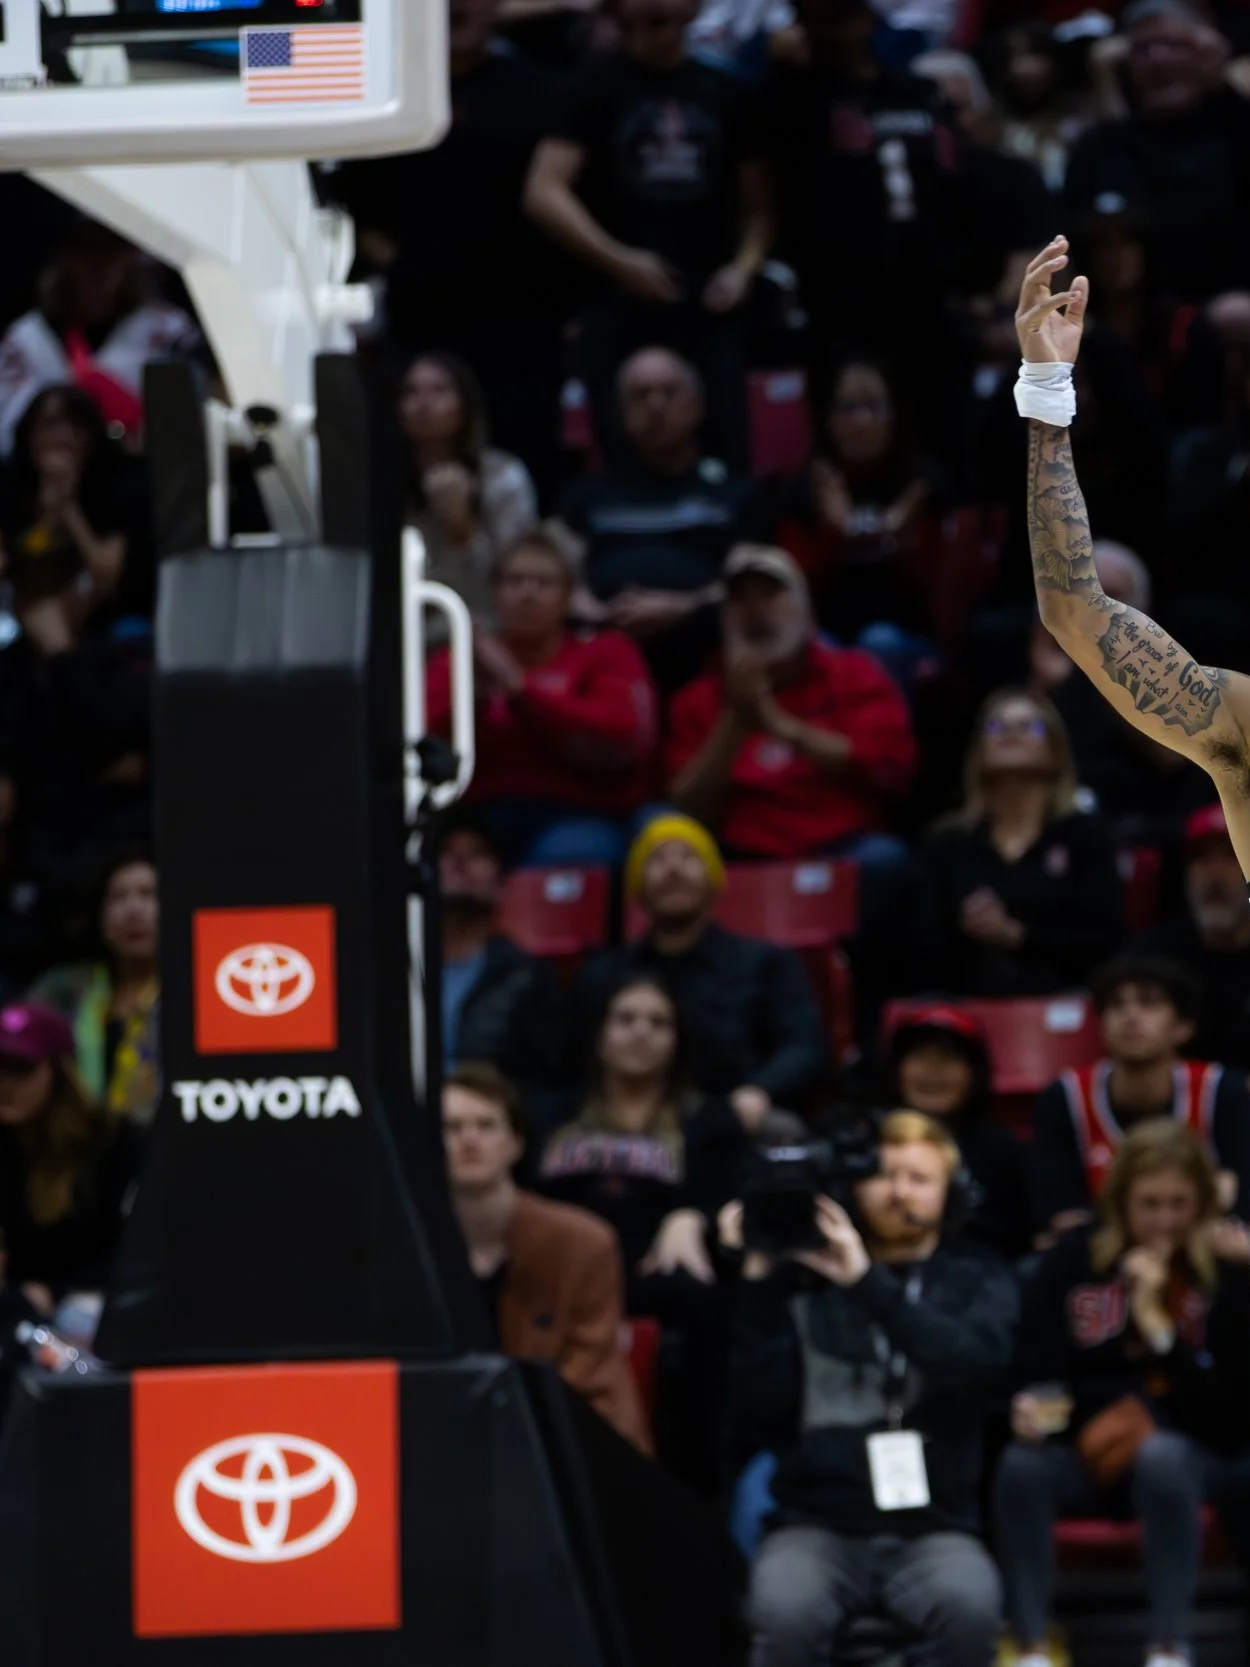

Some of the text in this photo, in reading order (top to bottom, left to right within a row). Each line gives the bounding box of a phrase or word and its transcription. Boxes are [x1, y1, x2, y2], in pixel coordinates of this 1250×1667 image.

[1143, 678, 1169, 698] what
[1179, 661, 1215, 706] God
[172, 1075, 362, 1123] TOYOTA
